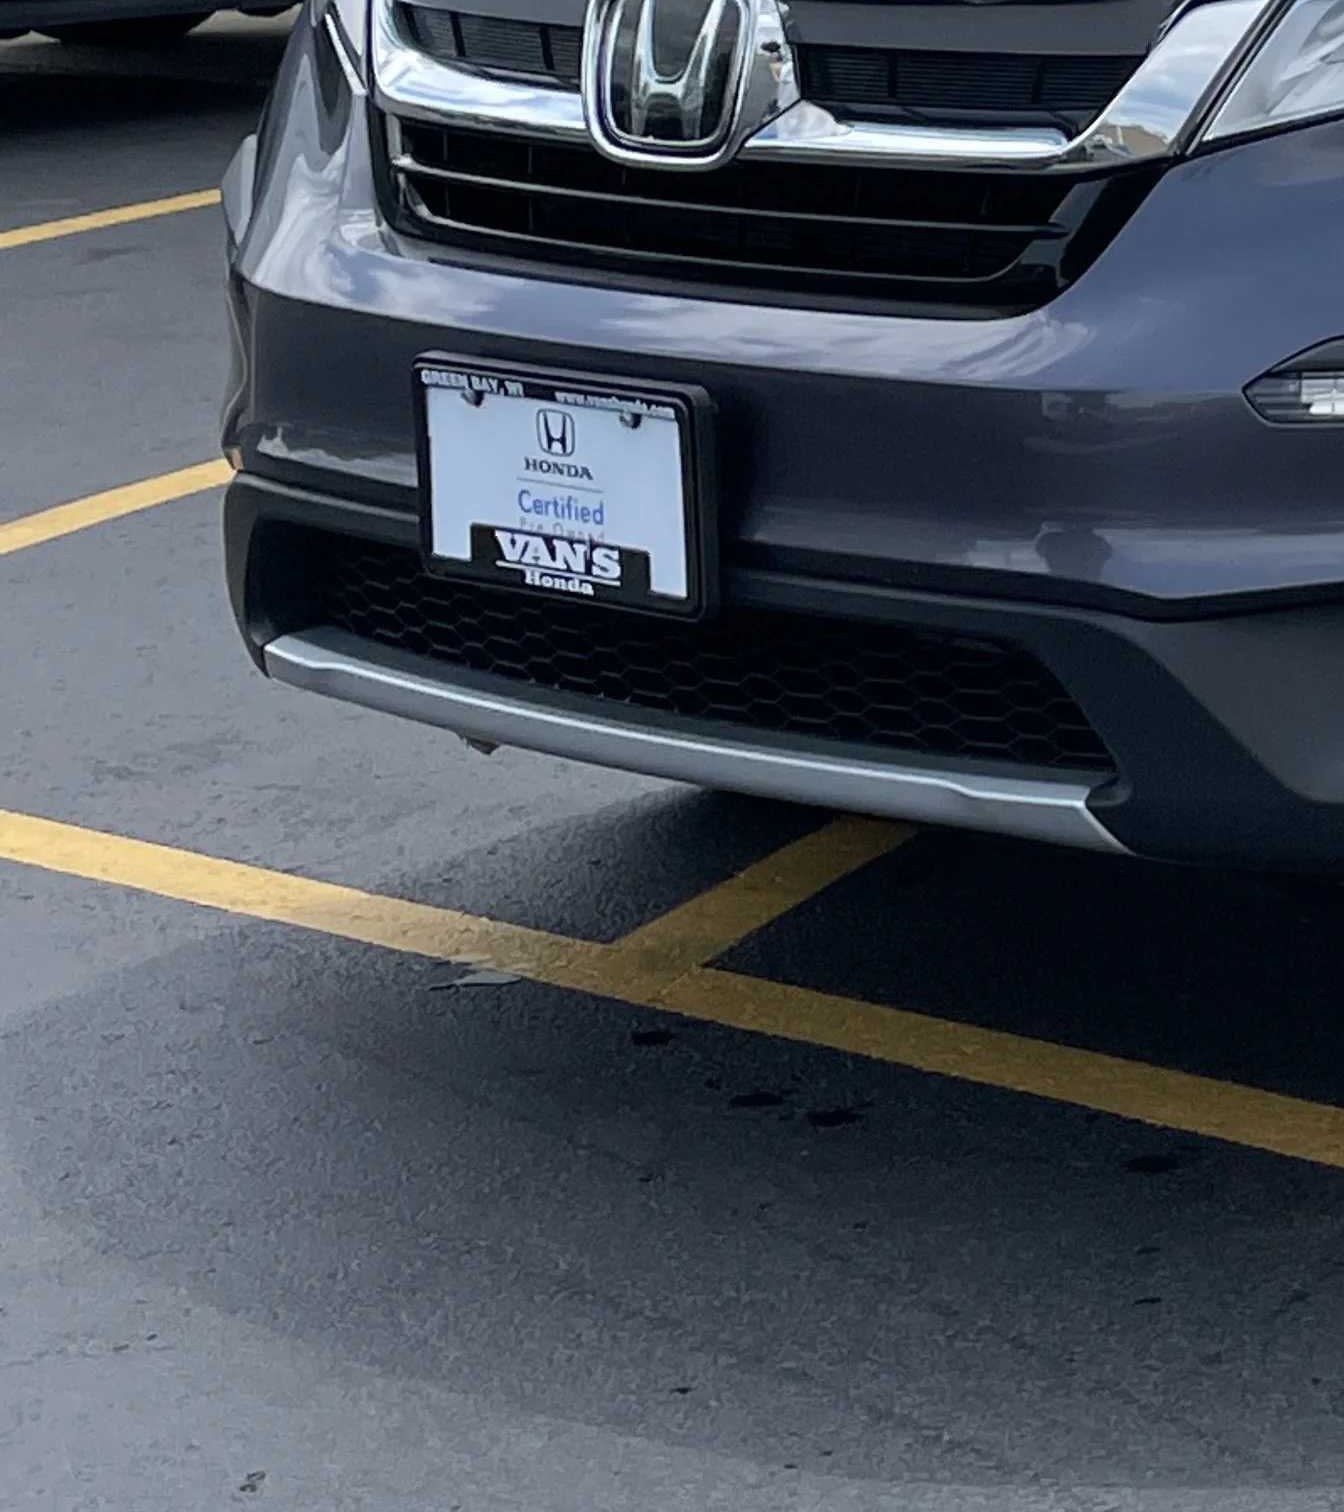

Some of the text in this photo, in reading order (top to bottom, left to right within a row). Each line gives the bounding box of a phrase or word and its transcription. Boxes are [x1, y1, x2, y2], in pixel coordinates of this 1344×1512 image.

[524, 456, 594, 481] HONDA
[517, 489, 605, 525] Certified
[524, 568, 595, 597] Honda
